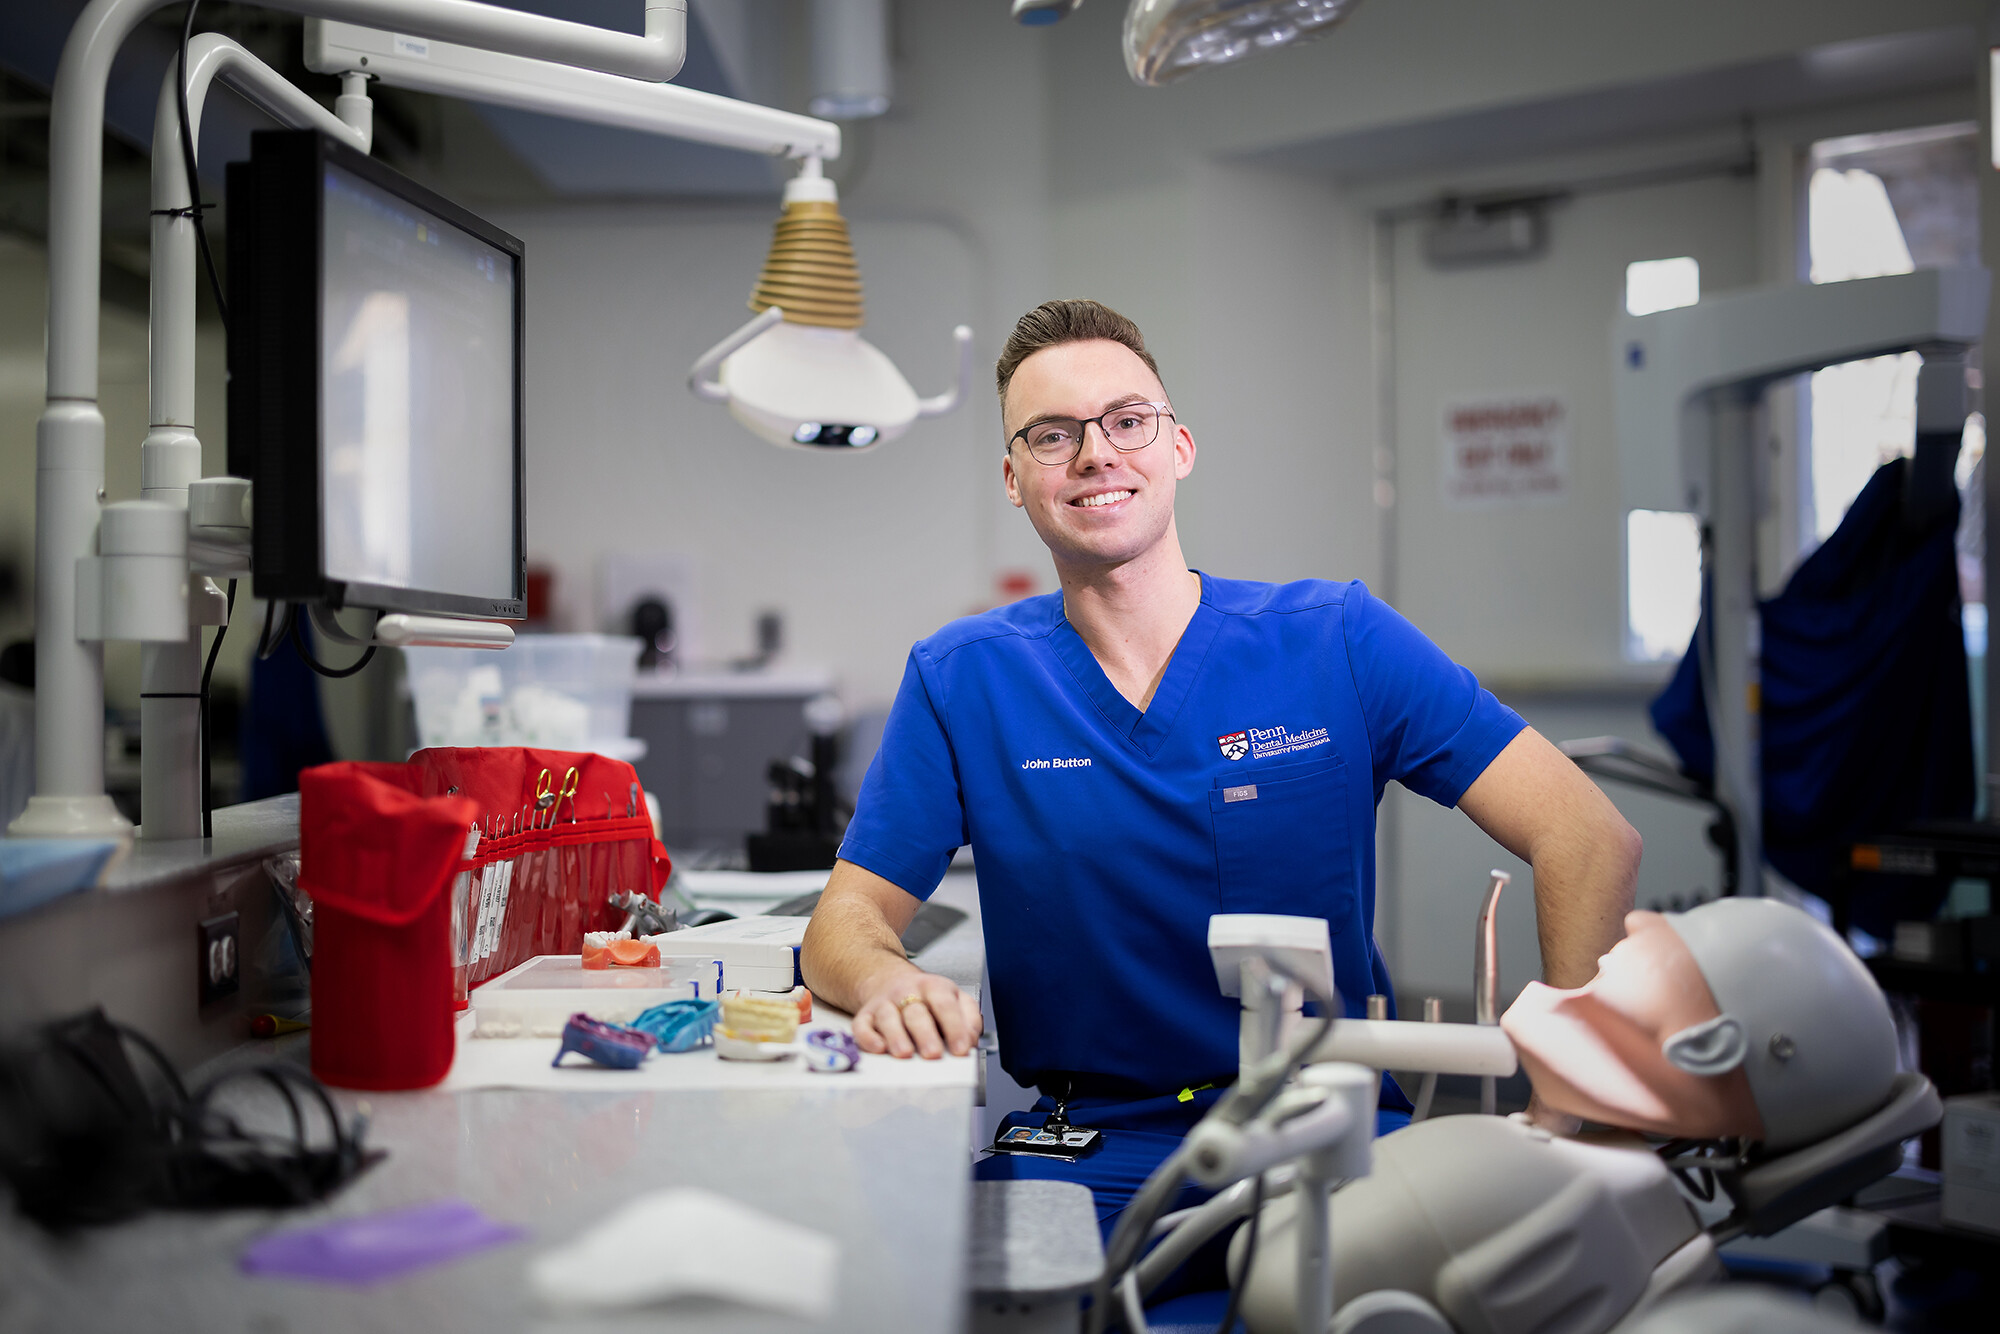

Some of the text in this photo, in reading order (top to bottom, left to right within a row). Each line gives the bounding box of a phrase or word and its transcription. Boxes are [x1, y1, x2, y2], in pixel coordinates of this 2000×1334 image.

[1248, 725, 1286, 742] Penn
[1252, 727, 1327, 751] Dental Medicine
[1021, 757, 1092, 770] John Button
[1233, 790, 1248, 798] FIGS
